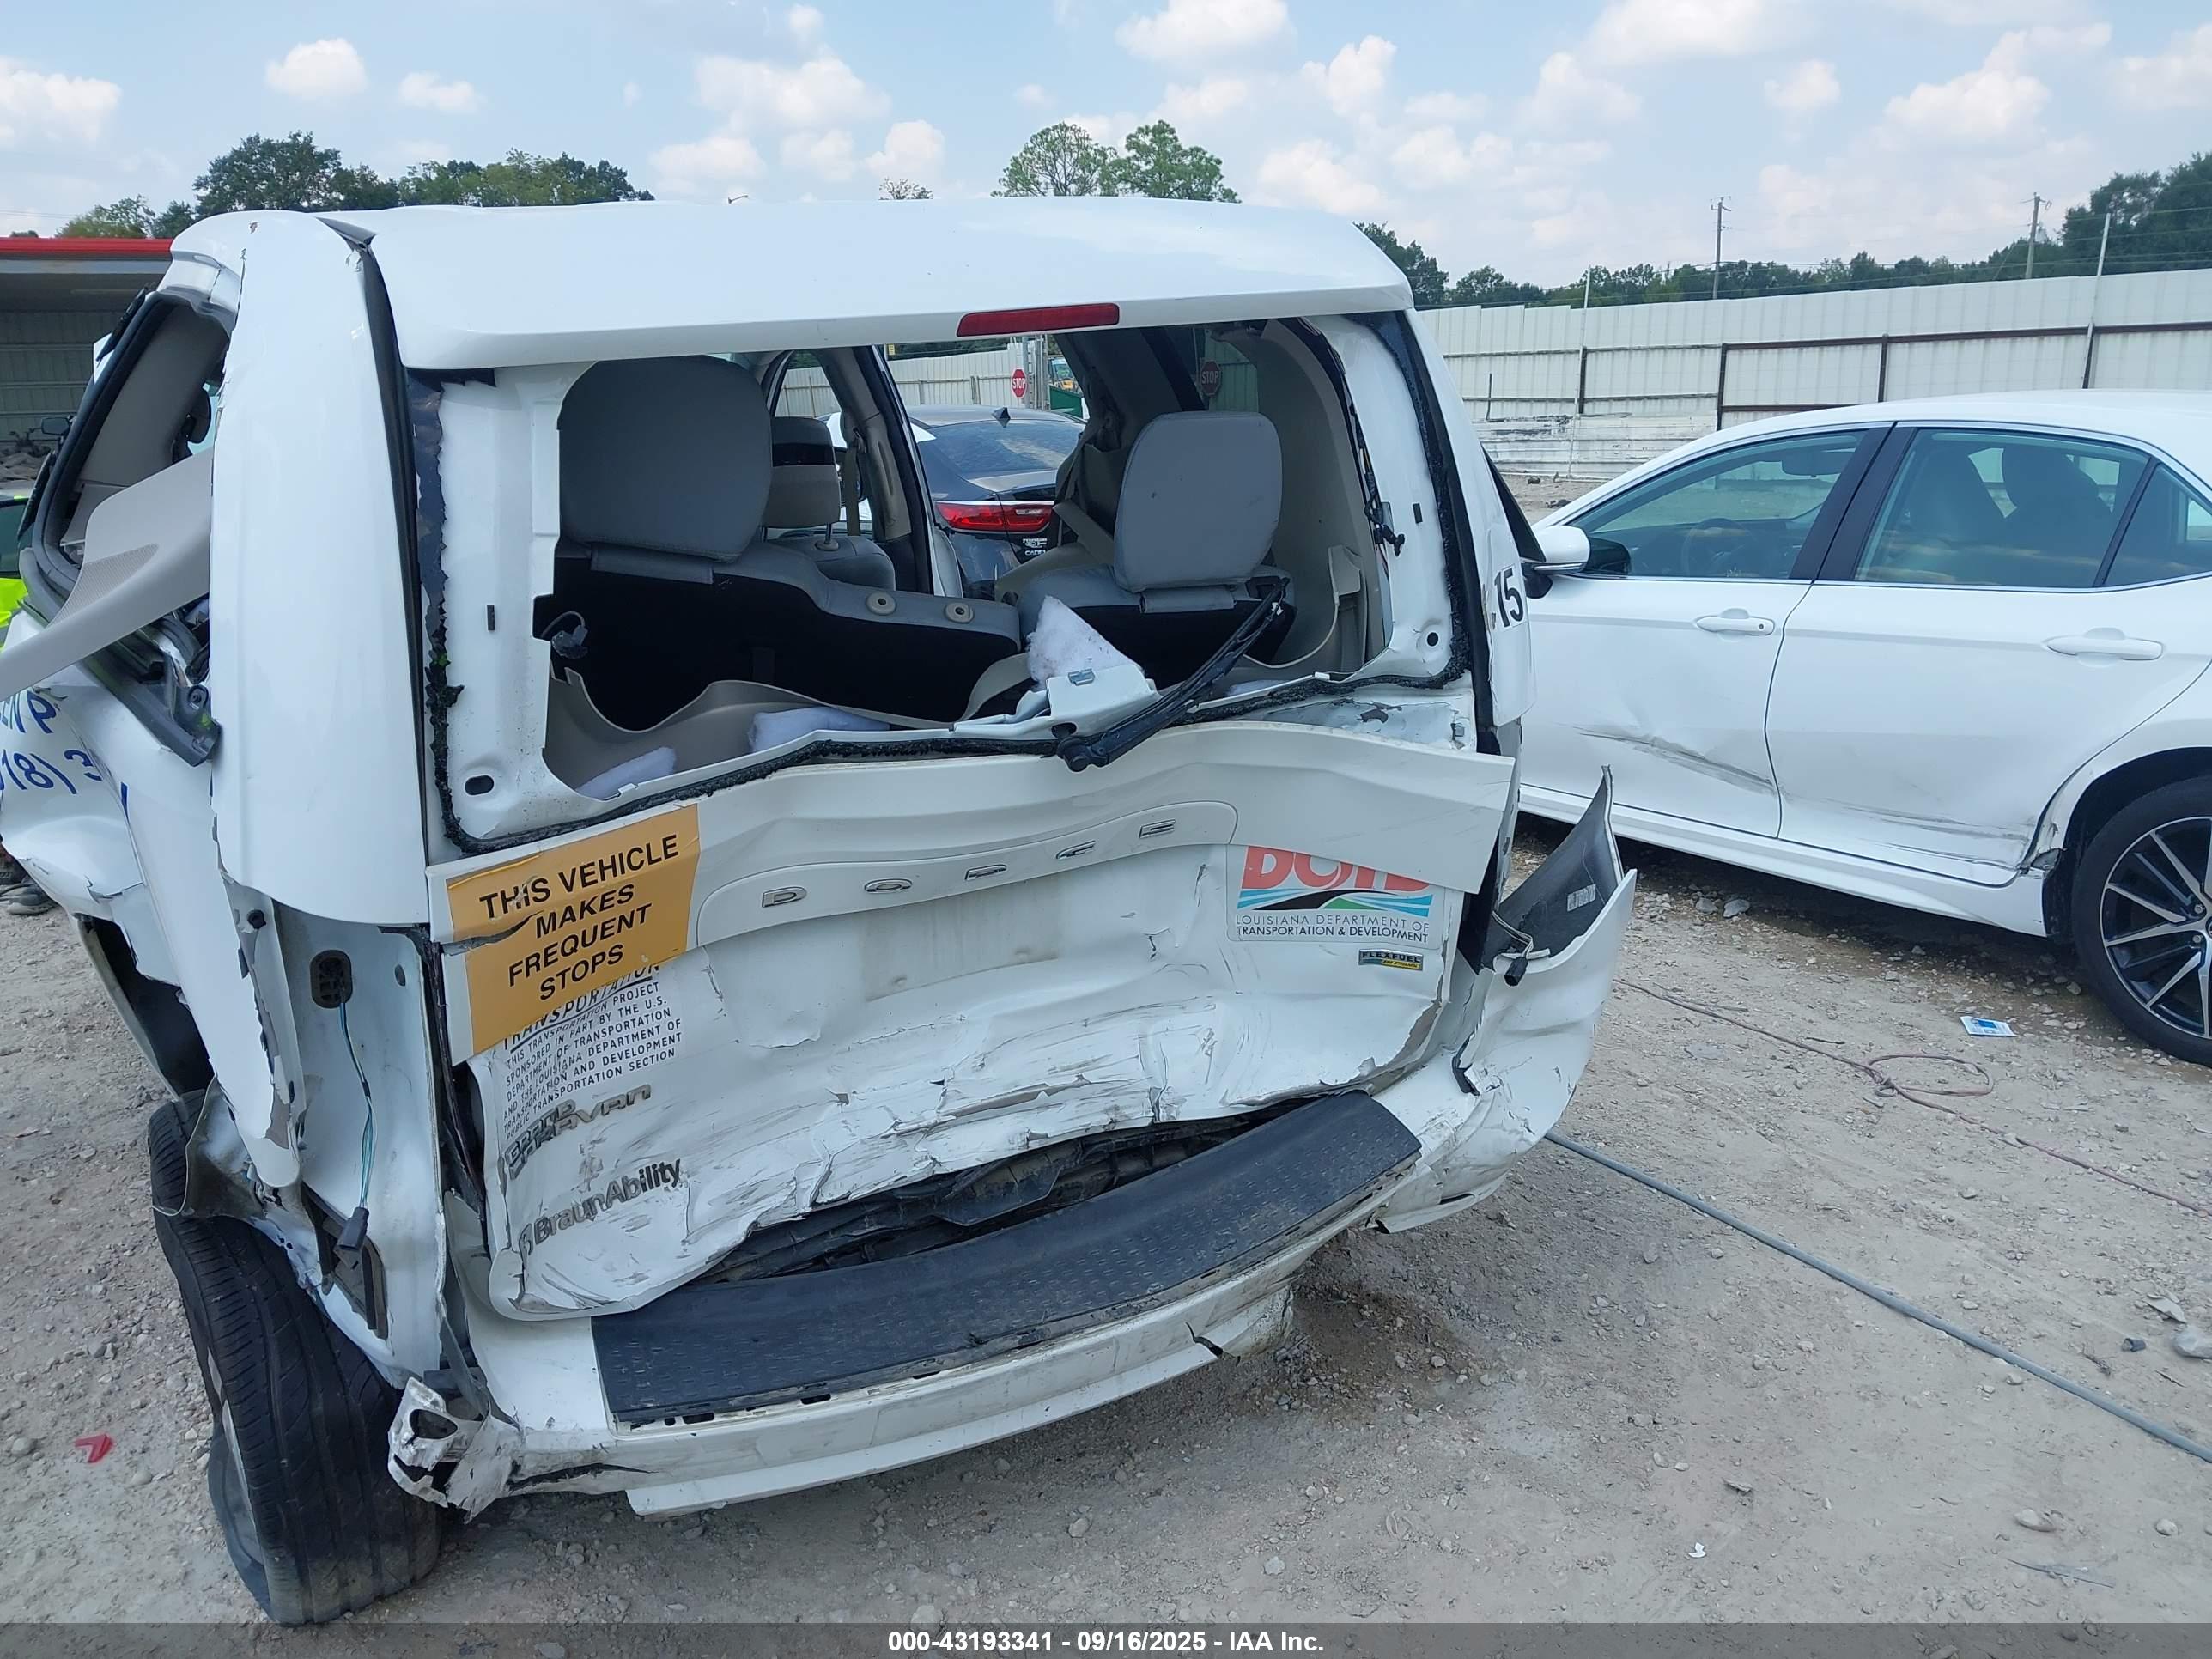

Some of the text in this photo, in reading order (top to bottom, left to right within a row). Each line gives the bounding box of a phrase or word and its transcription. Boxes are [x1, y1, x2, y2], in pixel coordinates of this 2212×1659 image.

[1012, 377, 1025, 389] STOP
[1202, 371, 1219, 384] STOP
[1495, 568, 1524, 628] 15
[479, 834, 679, 919] THIS VEHICLE
[536, 884, 635, 939] MAKES
[508, 903, 653, 988] FREQUENT
[1236, 915, 1429, 933] LOUISIANA DEPARTMENT OF
[1237, 926, 1429, 943] TRANSPORTATION & DEVELOPMENT
[1362, 951, 1422, 963] FLEXFUEL
[540, 944, 623, 1000] STOPS
[507, 981, 659, 1070] THIS TRANSPORTATION PROJECT
[507, 996, 666, 1086] SPONSORED IN PART BY THE U.S.
[507, 1007, 671, 1102] DEPARTMENT OF TRANSPORTATION
[503, 1032, 682, 1134] TRANSPORTATION AND DEVELOPMENT
[504, 1018, 681, 1121] AND THE LOUISIANA DEPARTMENT OF
[507, 1048, 676, 1141] PUBLIC TRANSPORTATION SECTION
[533, 1158, 681, 1245] BraunAbility
